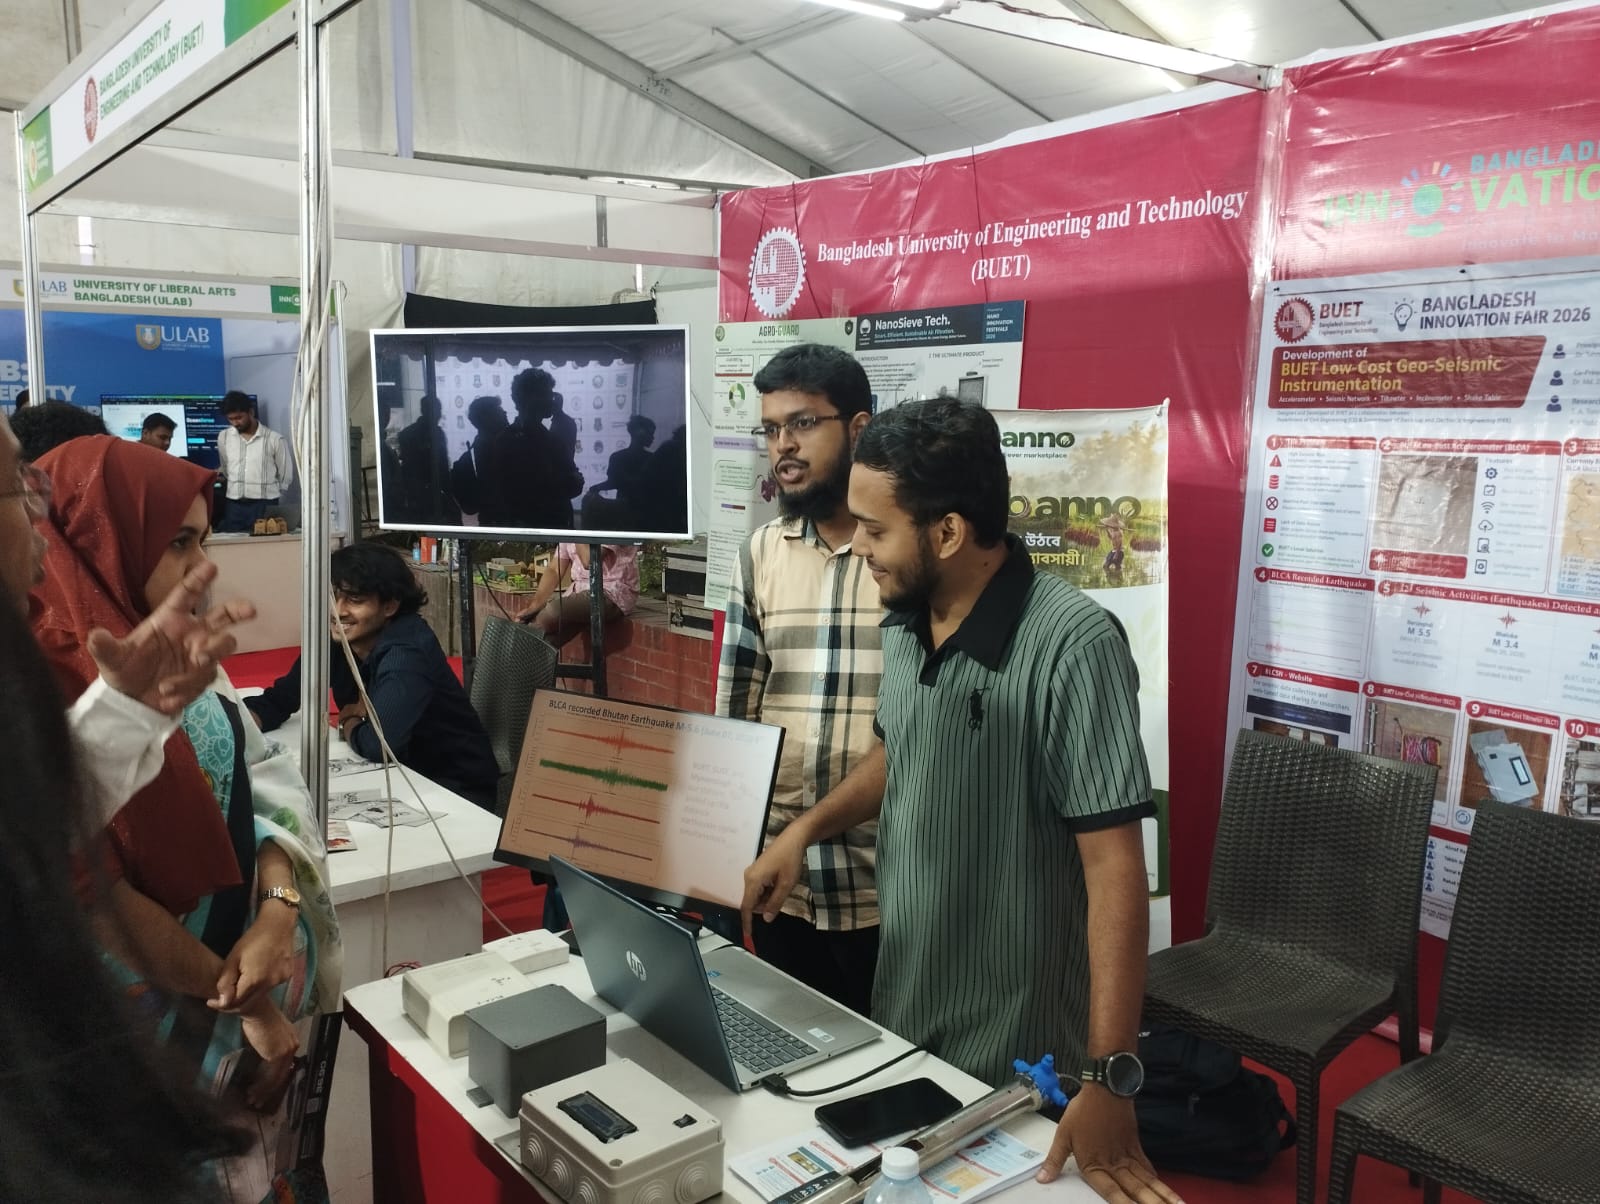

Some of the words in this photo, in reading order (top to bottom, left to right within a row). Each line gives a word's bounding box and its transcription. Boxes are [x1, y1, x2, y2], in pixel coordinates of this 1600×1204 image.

[163, 19, 171, 41] OF
[1470, 140, 1600, 174] BANGLAD
[817, 237, 893, 265] Bangladesh
[899, 228, 972, 256] University
[975, 223, 992, 246] of
[992, 211, 1093, 248] Engineering
[1096, 204, 1131, 230] and
[1136, 190, 1249, 225] Technology
[971, 254, 1031, 285] (BUET)
[39, 280, 67, 293] LAB
[73, 279, 140, 292] UNIVERSITY
[143, 283, 157, 292] OF
[159, 283, 206, 296] LIBERAL
[207, 286, 237, 297] ARTS
[74, 292, 151, 304] BANGLADESH
[153, 295, 193, 307] (ULAB)
[1421, 290, 1537, 313] BANGLADESH
[1319, 301, 1364, 319] BUET
[1419, 311, 1511, 330] INNOVATION
[1514, 310, 1549, 326] FAIR
[1552, 306, 1592, 323] 2026
[875, 316, 923, 331] NanoSieve
[925, 313, 951, 326] Tech.
[161, 325, 210, 343] ULAB
[1282, 349, 1353, 361] Development
[1355, 347, 1368, 358] of
[1281, 362, 1319, 376] BUET
[1321, 360, 1393, 376] Low-Cost
[1396, 355, 1504, 373] Geo-Seismic
[0, 384, 76, 401] ERTY
[1279, 376, 1402, 392] Instrumentation
[1000, 431, 1075, 448] anno
[1569, 441, 1577, 452] 3
[1024, 452, 1068, 460] marketplace
[1025, 532, 1061, 547] উঠবে
[1259, 570, 1266, 579] 4
[1271, 570, 1291, 580] BLCA
[1292, 572, 1325, 584] Recorded
[1325, 576, 1367, 589] Earthquake
[1383, 582, 1391, 593] 5
[1415, 586, 1447, 598] Seismic
[1449, 590, 1488, 602] Activities
[1490, 593, 1550, 610] (Earthquakes)
[1552, 603, 1593, 615] Detected
[1407, 627, 1415, 635] M
[1418, 628, 1432, 637] 5.5
[1492, 638, 1501, 647] M
[1503, 639, 1519, 649] 3.4
[1589, 651, 1598, 661] M
[1251, 665, 1258, 674] 7
[1288, 671, 1313, 683] Website
[1367, 684, 1375, 694] 8
[568, 704, 601, 716] recorded
[602, 708, 629, 721] Bhutan
[631, 713, 675, 730] Earthquake
[1471, 703, 1480, 715] 9
[1570, 722, 1585, 735] 10
[626, 950, 646, 981] hp
